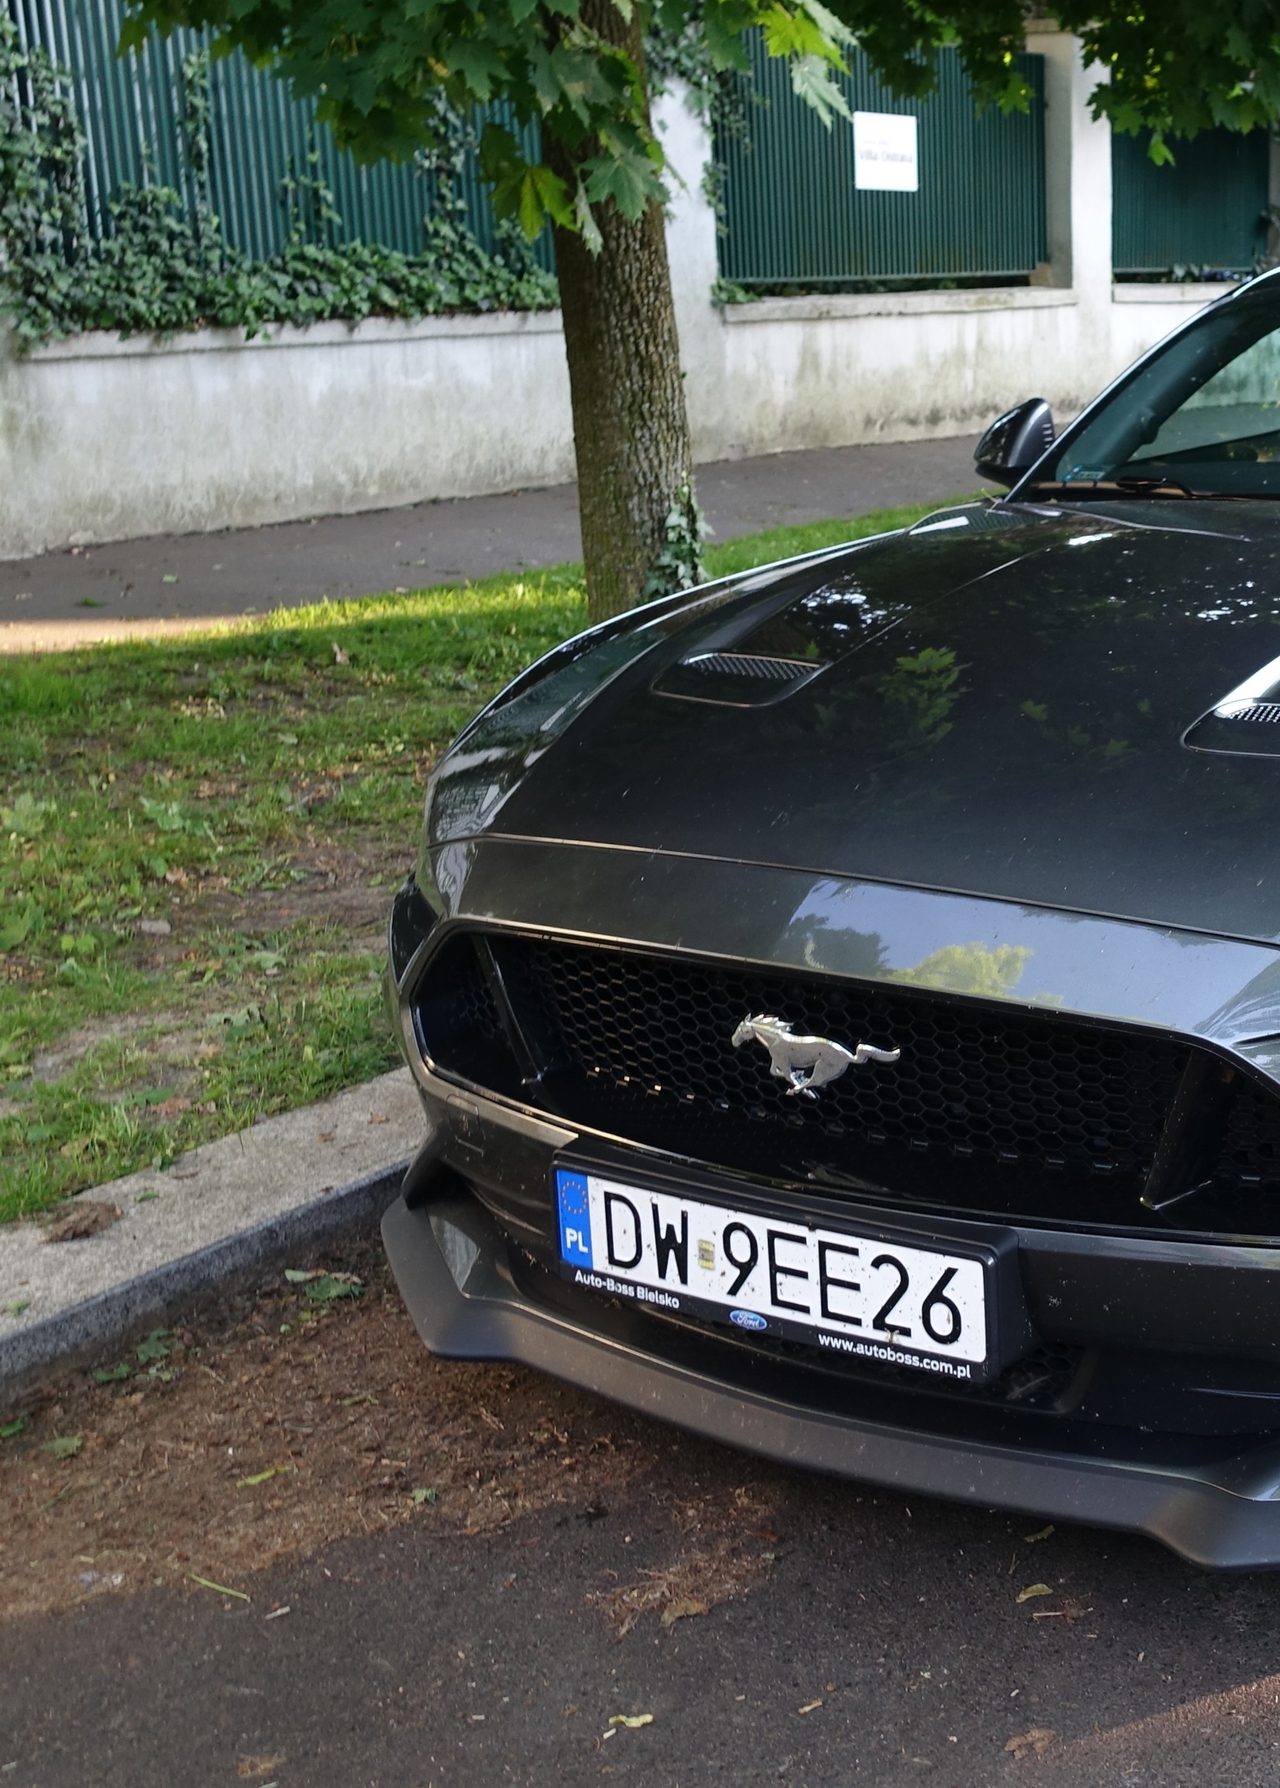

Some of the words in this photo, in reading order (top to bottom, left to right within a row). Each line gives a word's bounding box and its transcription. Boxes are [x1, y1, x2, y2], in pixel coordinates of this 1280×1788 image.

[565, 1227, 589, 1254] PL
[574, 1269, 635, 1298] Auto-Boss
[636, 1285, 680, 1309] Bielsko
[604, 1191, 689, 1286] DW
[721, 1222, 962, 1345] 9EE26
[818, 1333, 971, 1379] www.autoboss.com.pl
